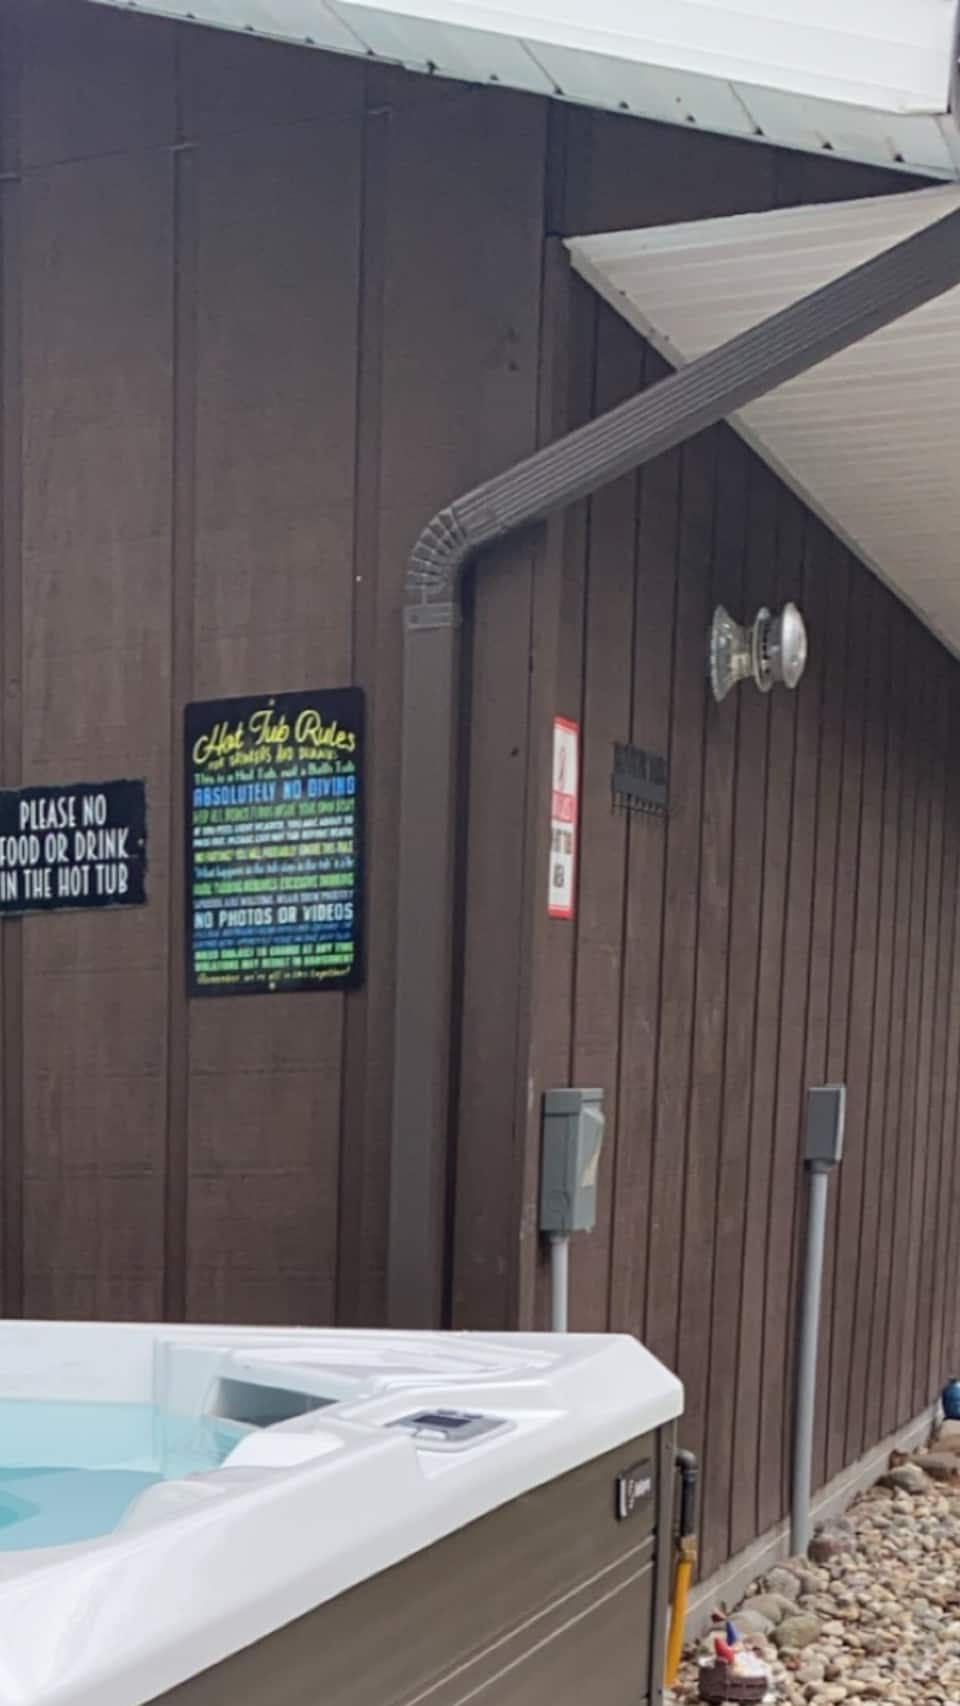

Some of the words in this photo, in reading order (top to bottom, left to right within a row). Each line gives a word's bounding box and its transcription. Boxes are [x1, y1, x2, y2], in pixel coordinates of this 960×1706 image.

[193, 721, 244, 764] Hot
[249, 710, 290, 745] Tub
[295, 709, 355, 751] Rules
[193, 781, 277, 808] ABSOLUTELY
[283, 779, 302, 800] NO
[307, 775, 356, 798] DIVING
[19, 796, 76, 831] PLEASE
[82, 793, 107, 827] NO
[44, 832, 69, 865] OR
[74, 827, 129, 862] DRINK
[0, 870, 18, 902] IN
[23, 867, 52, 899] THE
[58, 865, 91, 897] HOT
[95, 862, 128, 895] TUB
[194, 910, 213, 929] NO
[219, 907, 272, 928] PHOTOS
[278, 906, 297, 925] OR
[303, 902, 354, 922] VIDEOS
